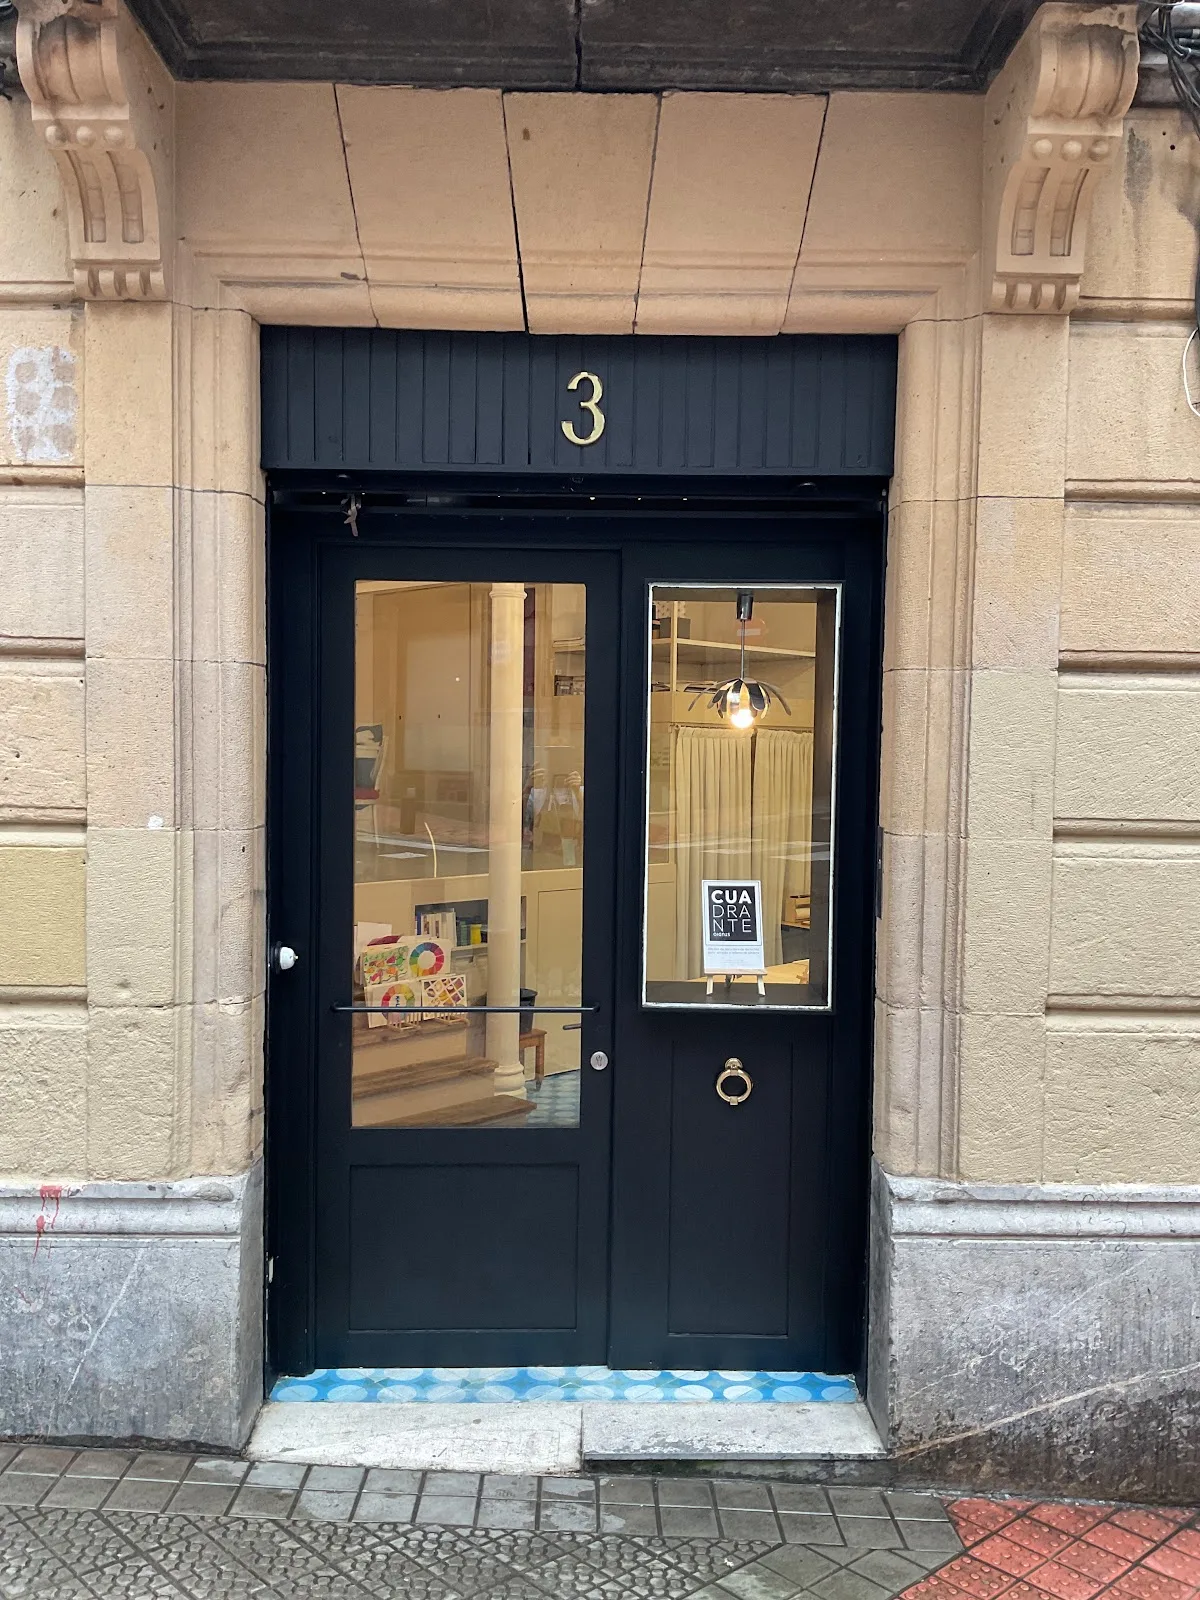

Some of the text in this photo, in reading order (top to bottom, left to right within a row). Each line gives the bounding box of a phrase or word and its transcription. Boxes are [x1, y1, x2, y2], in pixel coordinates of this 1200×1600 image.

[561, 371, 605, 445] 3
[711, 889, 752, 904] CUA
[712, 904, 751, 918] DRA
[713, 919, 752, 932] NTE
